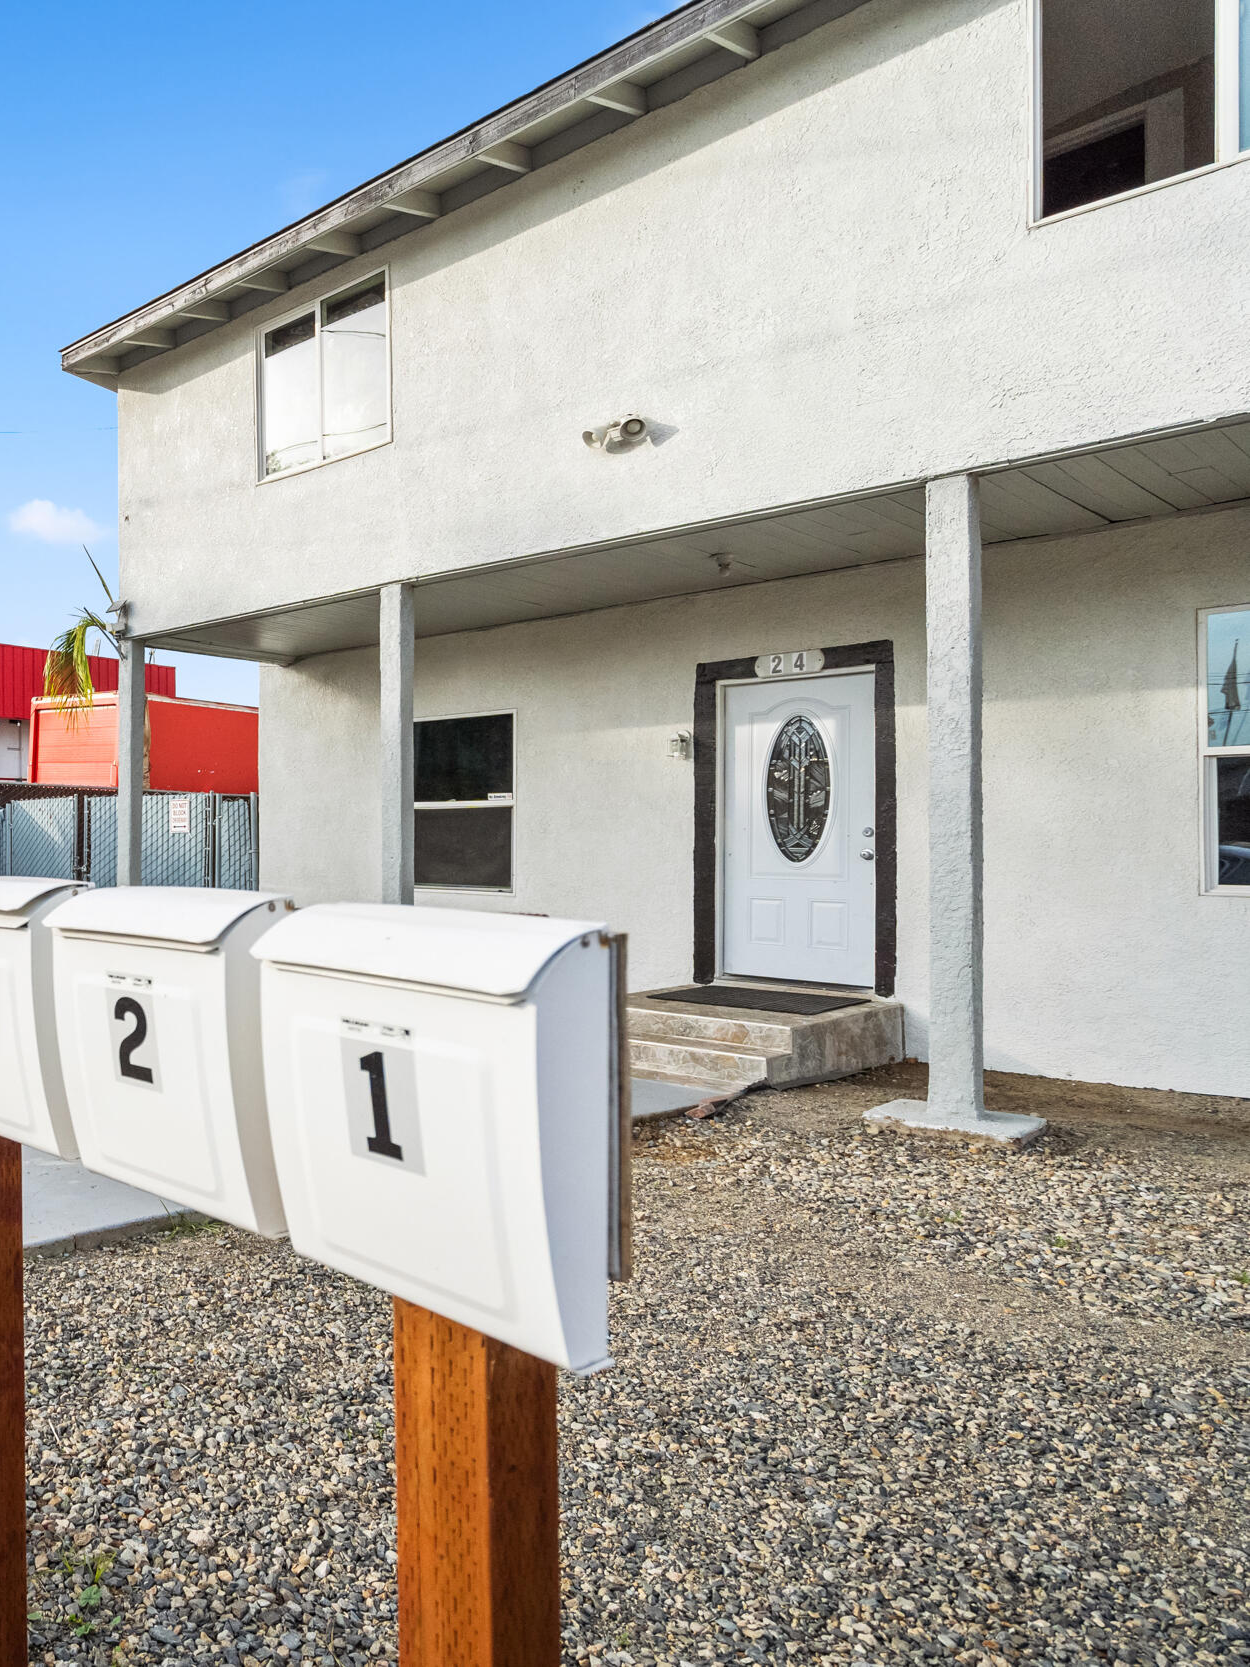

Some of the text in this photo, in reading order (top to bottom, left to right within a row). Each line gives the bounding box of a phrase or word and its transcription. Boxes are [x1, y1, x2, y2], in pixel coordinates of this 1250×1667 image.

[772, 653, 805, 674] 24
[114, 996, 154, 1084] 2
[360, 1051, 404, 1162] 1
